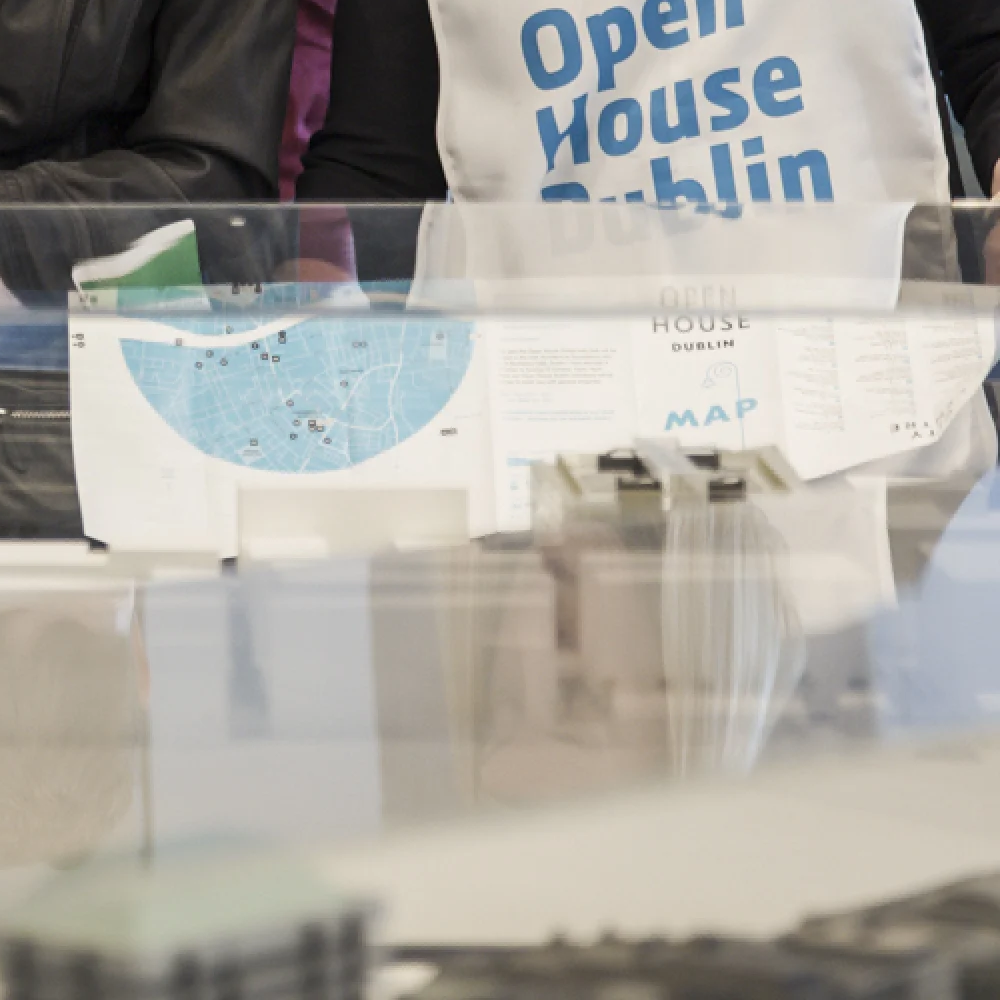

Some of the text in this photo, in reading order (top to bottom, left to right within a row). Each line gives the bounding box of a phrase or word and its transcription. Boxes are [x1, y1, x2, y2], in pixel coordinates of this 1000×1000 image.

[535, 55, 804, 173] House
[540, 135, 834, 217] blin
[651, 310, 751, 333] HOUSE
[671, 339, 735, 352] DUBLIN
[663, 397, 759, 432] MAP
